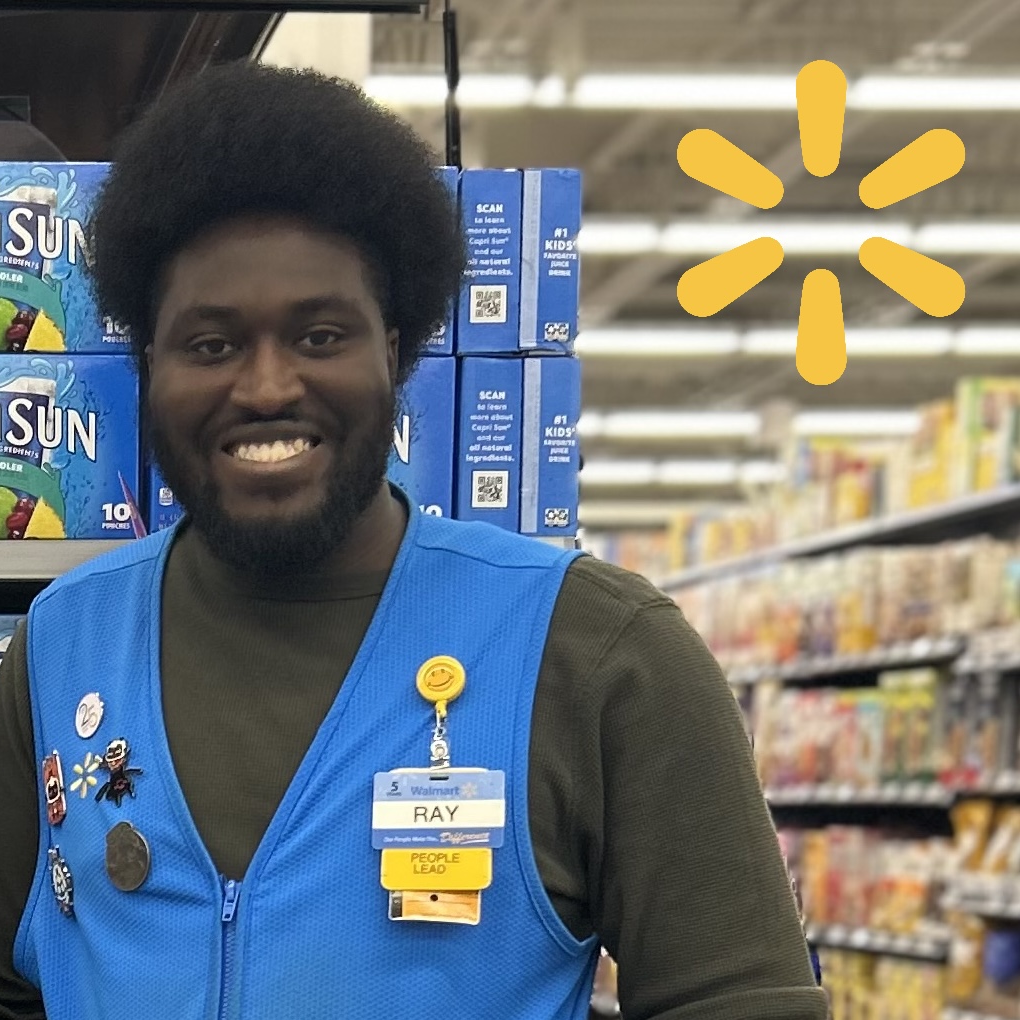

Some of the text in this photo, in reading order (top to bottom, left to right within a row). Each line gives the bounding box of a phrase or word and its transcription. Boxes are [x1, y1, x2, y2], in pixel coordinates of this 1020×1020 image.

[476, 204, 504, 213] SCAN
[554, 228, 568, 238] #1
[479, 390, 505, 400] SCAN
[553, 415, 568, 425] #1
[102, 503, 131, 521] 10
[390, 781, 460, 796] 5 Walmart
[414, 805, 459, 823] RAY
[411, 852, 460, 863] PEOPLE
[413, 864, 447, 875] LEAD
